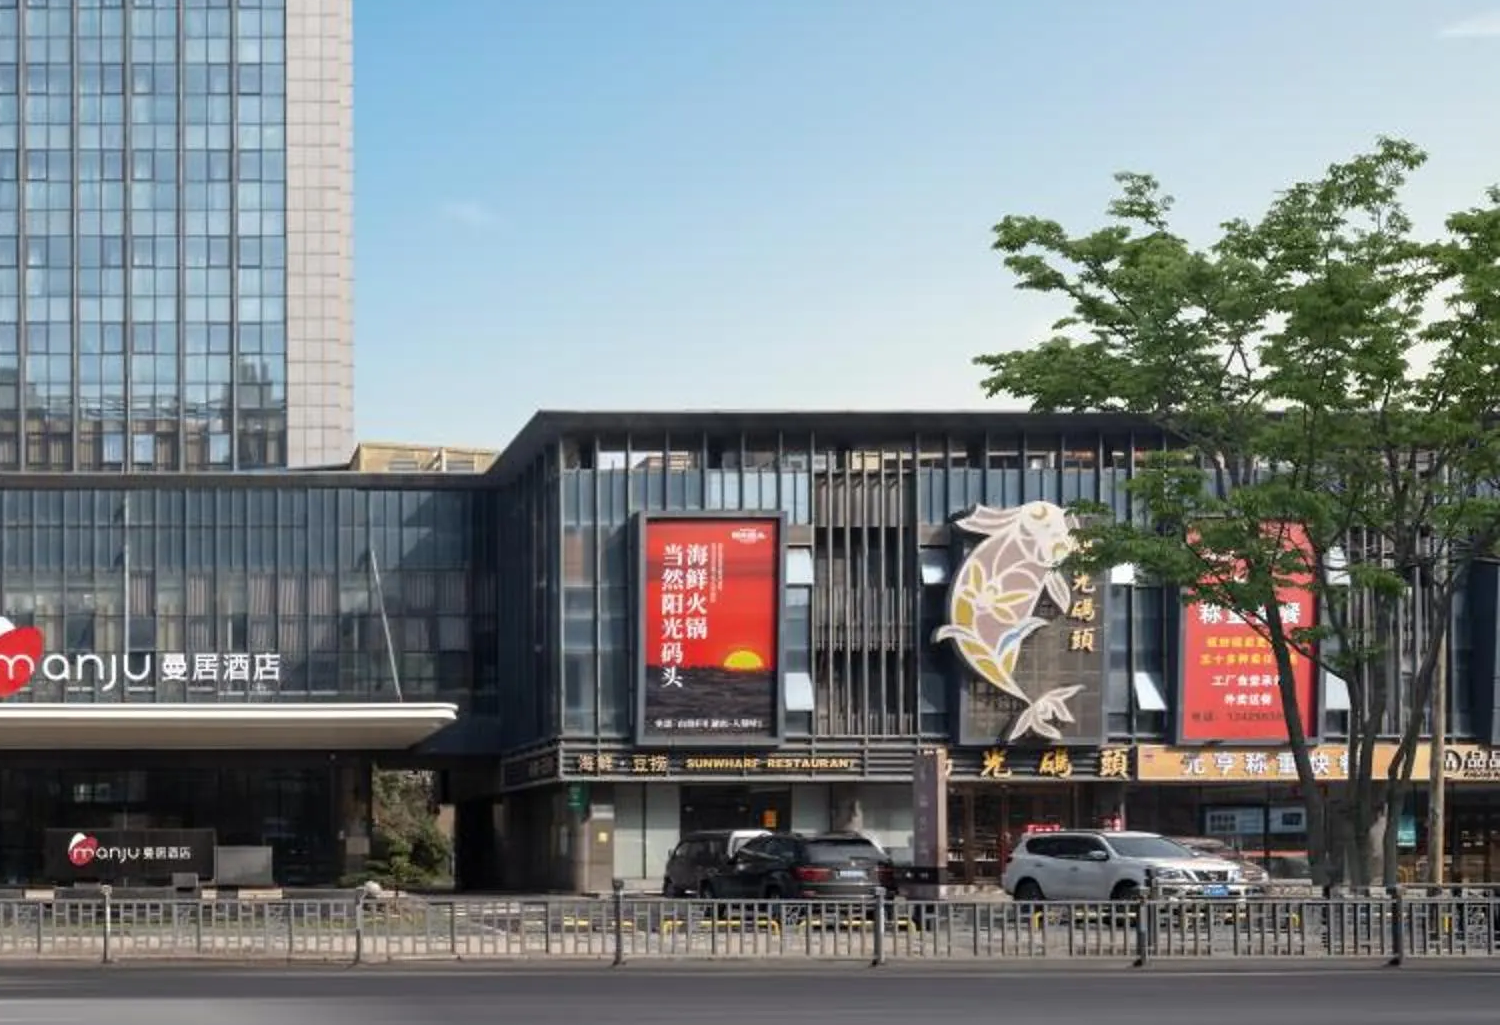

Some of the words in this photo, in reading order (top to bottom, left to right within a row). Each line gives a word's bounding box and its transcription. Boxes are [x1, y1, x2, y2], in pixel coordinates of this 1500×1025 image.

[661, 542, 683, 688] 当然阳光码头
[686, 542, 708, 639] 海鲜火锅
[1071, 537, 1096, 652] 光碼頭
[161, 652, 282, 683] 曼居酒店
[946, 747, 1130, 778] 光碼頭
